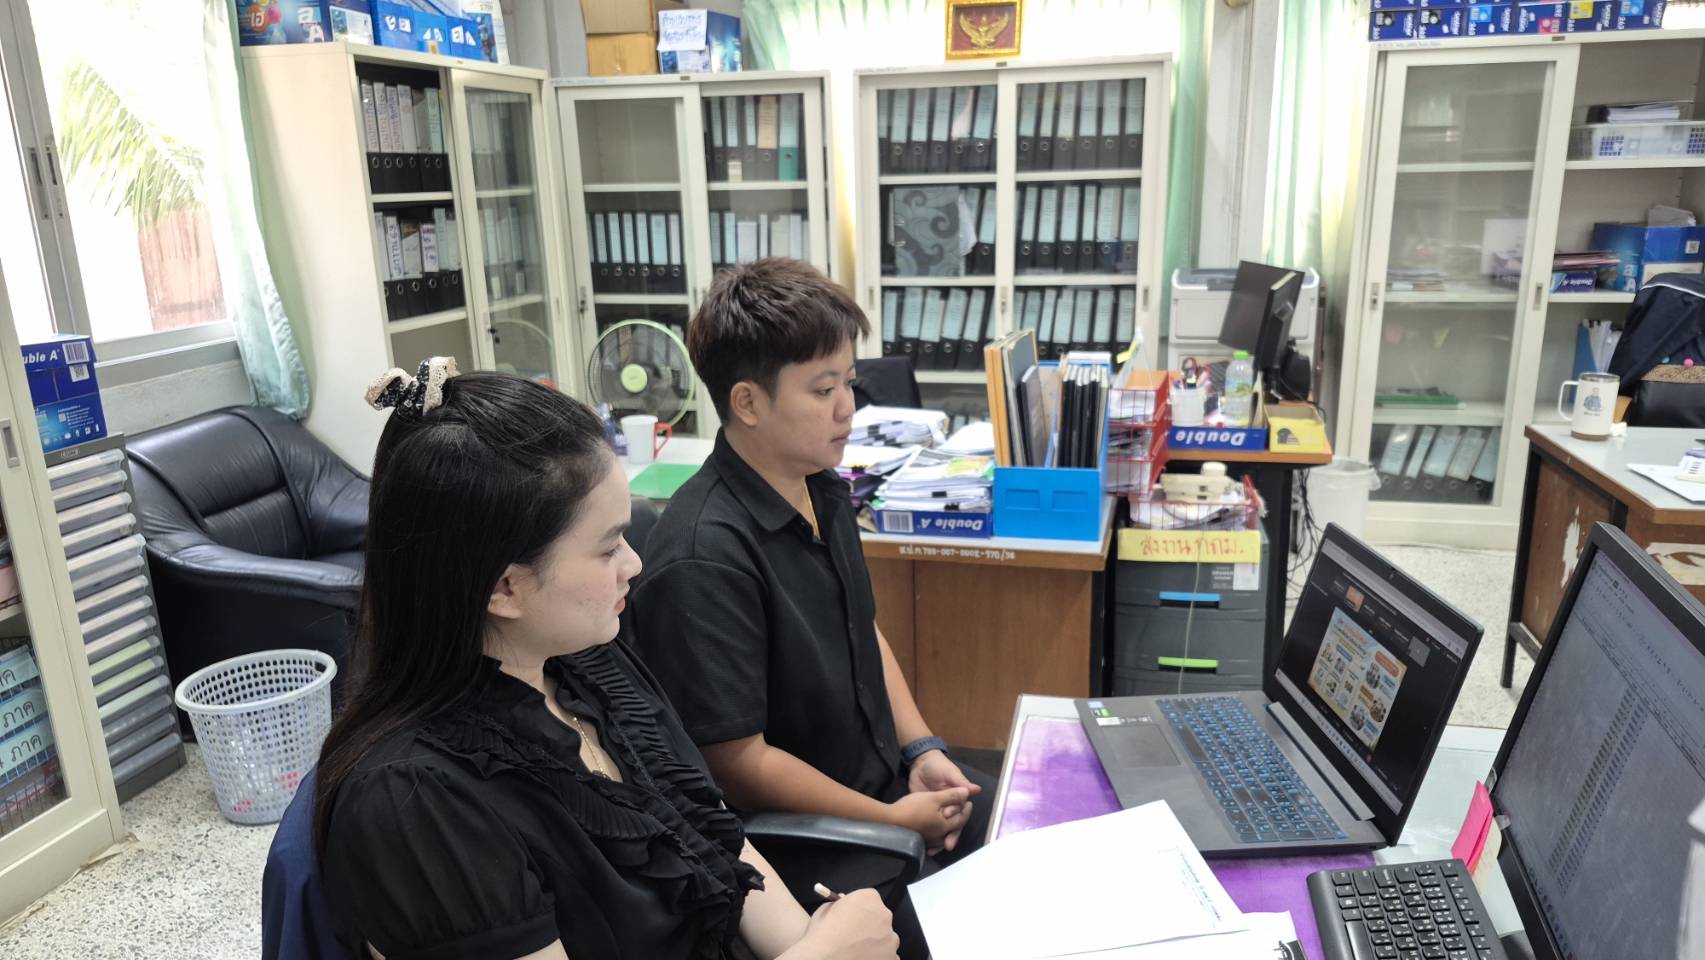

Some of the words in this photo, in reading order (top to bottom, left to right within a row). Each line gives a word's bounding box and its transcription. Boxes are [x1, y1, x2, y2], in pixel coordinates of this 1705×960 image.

[50, 350, 58, 361] A
[1175, 429, 1247, 446] Double
[921, 518, 932, 529] A
[935, 518, 984, 531] Double
[3, 700, 36, 729] ภาค
[11, 733, 42, 762] ภาค
